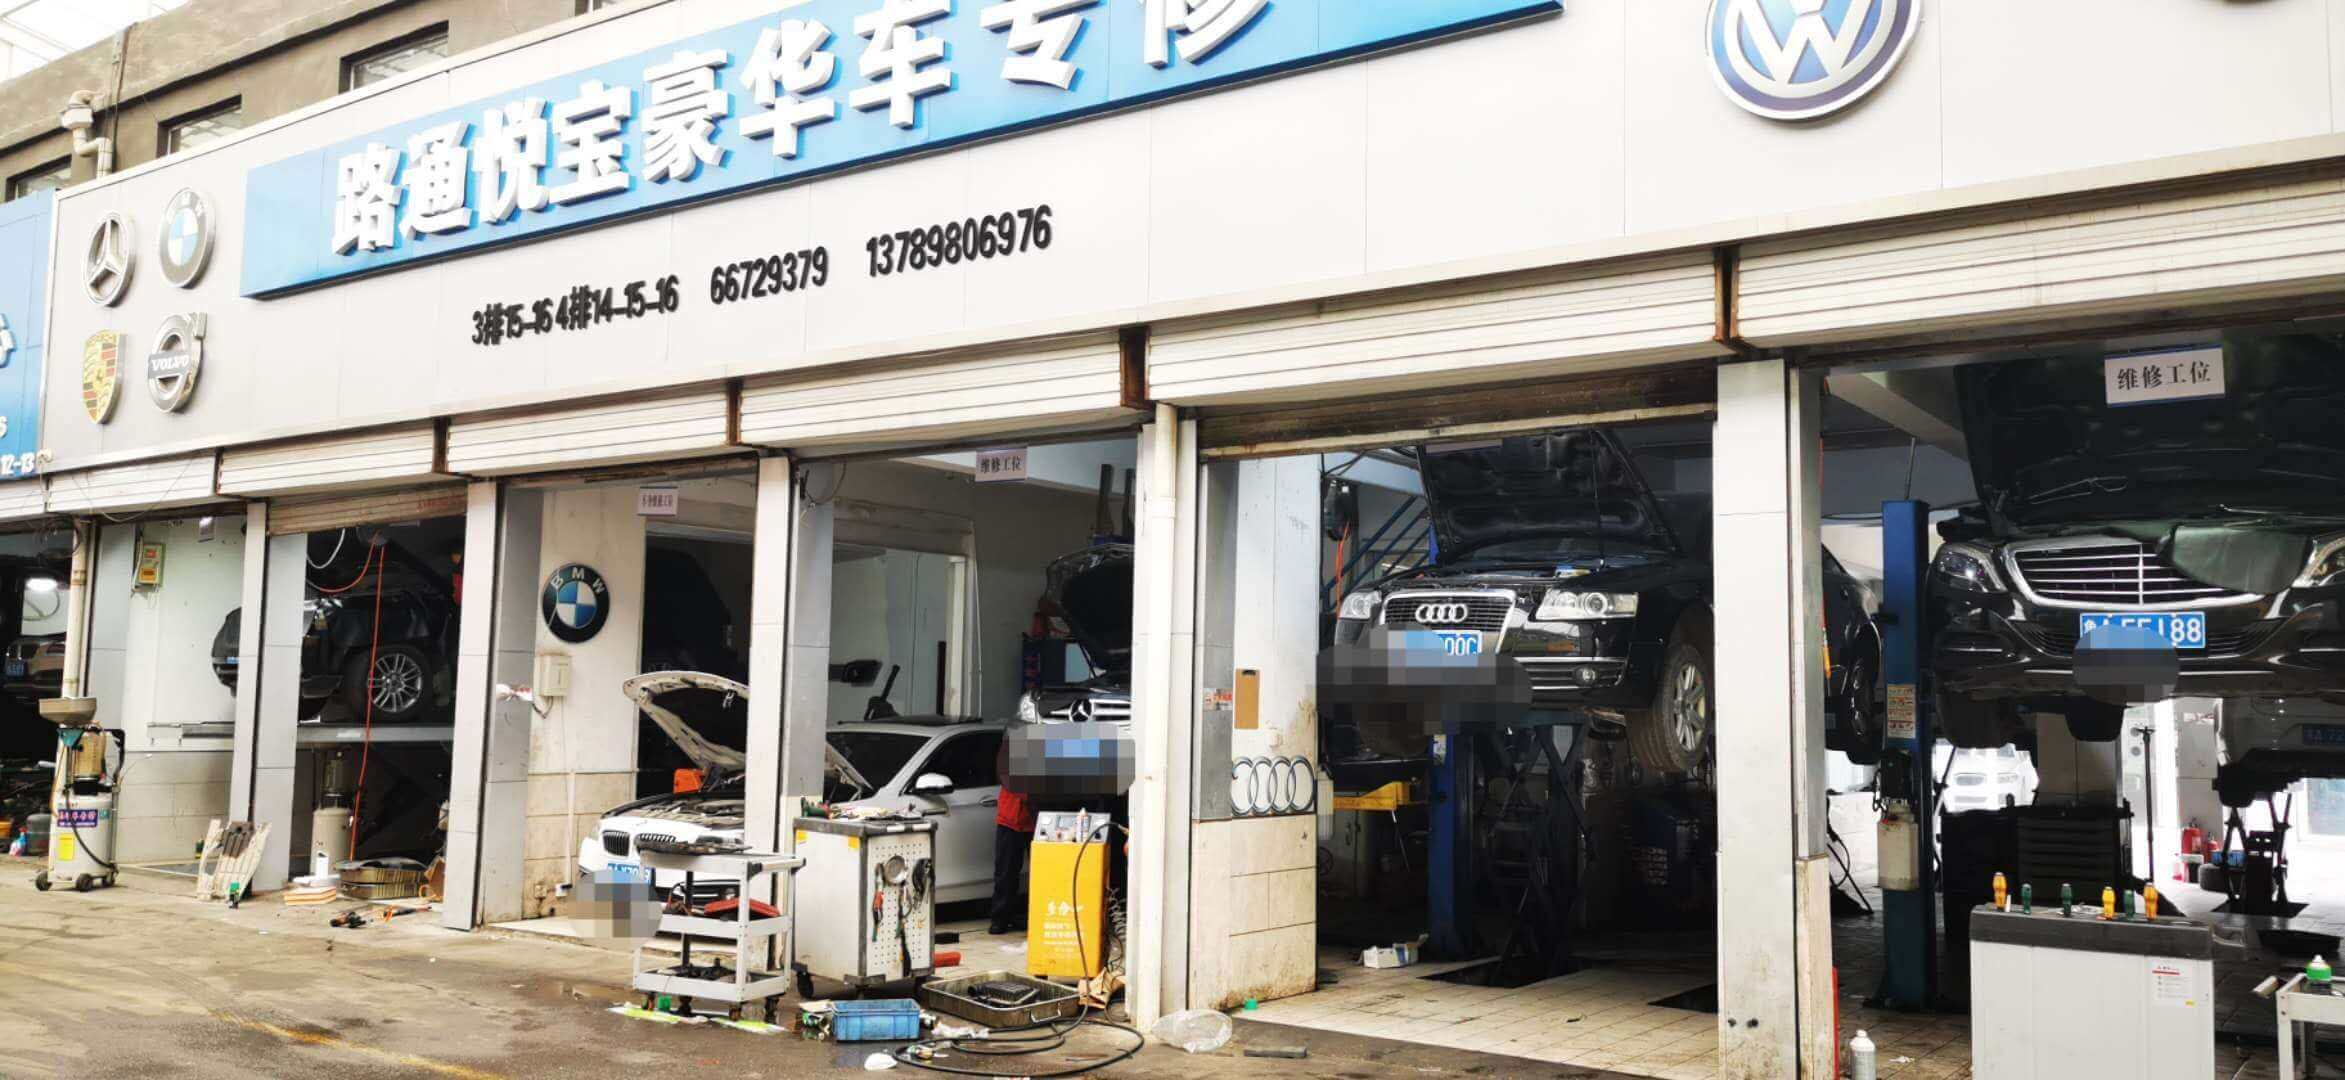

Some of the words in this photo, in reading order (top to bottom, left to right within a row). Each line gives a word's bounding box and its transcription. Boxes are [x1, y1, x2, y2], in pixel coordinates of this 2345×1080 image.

[710, 246, 829, 304] 66729379
[865, 204, 1053, 278] 13789806976
[151, 354, 190, 371] VOLVO
[2117, 361, 2211, 390] 维修工位
[981, 455, 1023, 474] 维修工位
[550, 566, 606, 594] BMW
